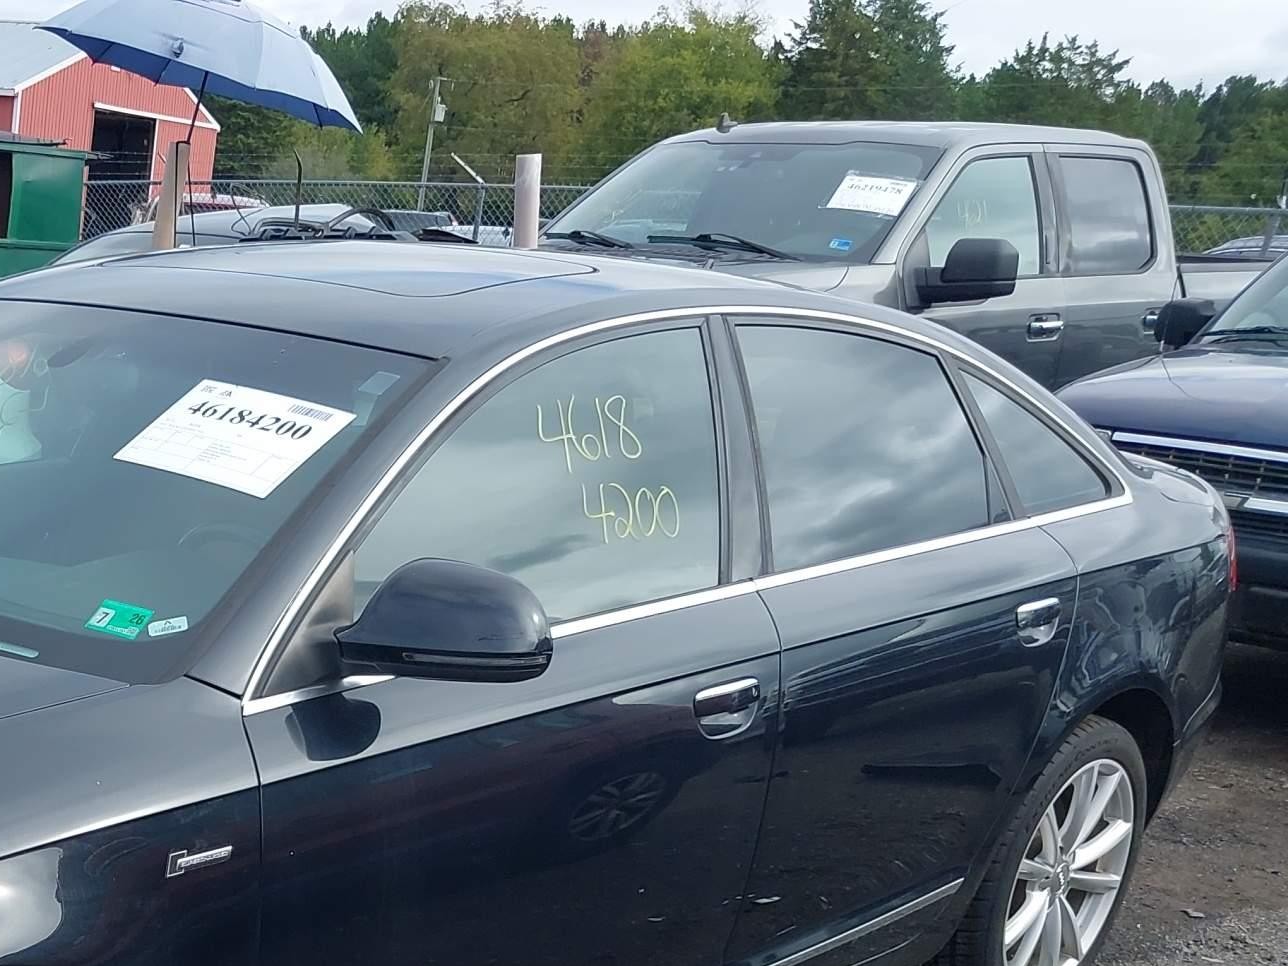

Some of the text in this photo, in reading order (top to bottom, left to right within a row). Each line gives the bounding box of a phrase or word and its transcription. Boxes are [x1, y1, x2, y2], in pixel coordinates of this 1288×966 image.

[187, 399, 313, 441] 46184200
[536, 393, 643, 474] 4618
[580, 481, 681, 544] 4200
